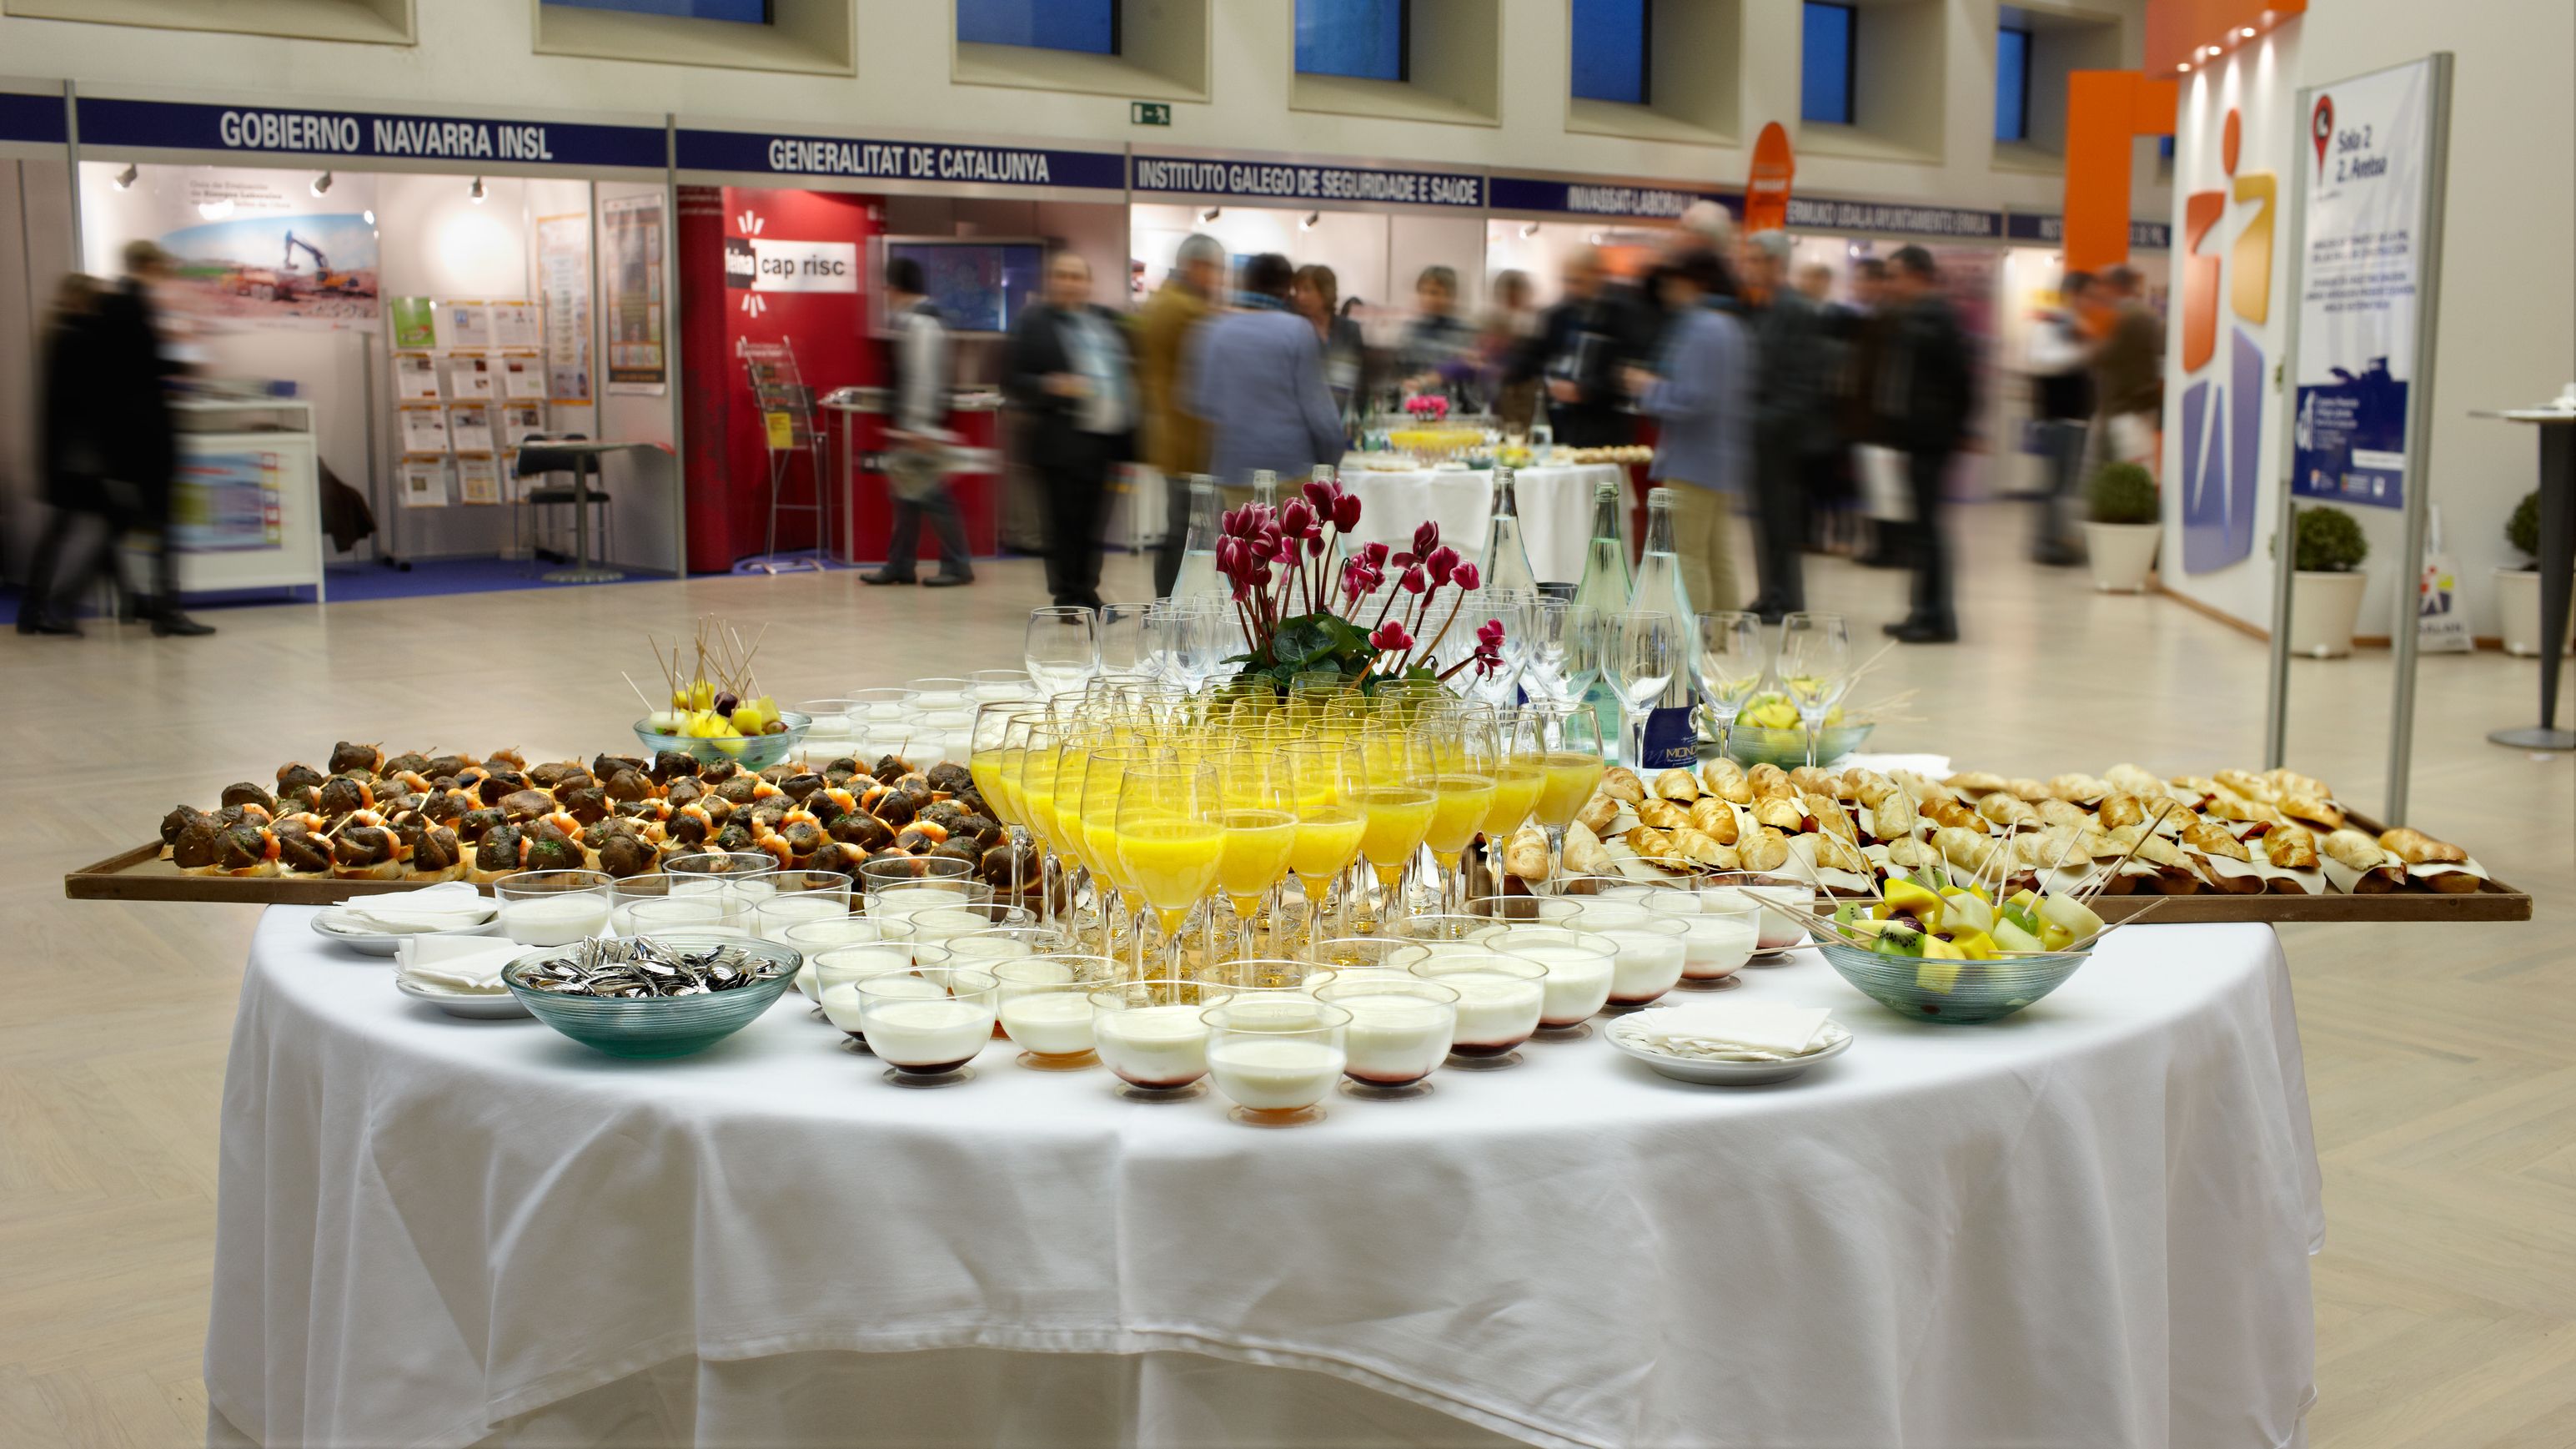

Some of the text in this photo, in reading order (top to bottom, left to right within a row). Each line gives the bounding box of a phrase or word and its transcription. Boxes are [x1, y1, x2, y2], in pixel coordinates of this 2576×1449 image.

[220, 111, 553, 161] GOBIERNO NAVARRA INSL
[768, 139, 1050, 182] GENERALITAT DE CATALUNYA
[1137, 161, 1227, 191] INSTITUTO
[1229, 165, 1292, 195] GALEGO
[1298, 171, 1319, 196] DE
[1322, 172, 1416, 201] SEGURIDADE
[1419, 176, 1429, 200] E
[762, 259, 795, 279] cap
[803, 254, 846, 276] risc
